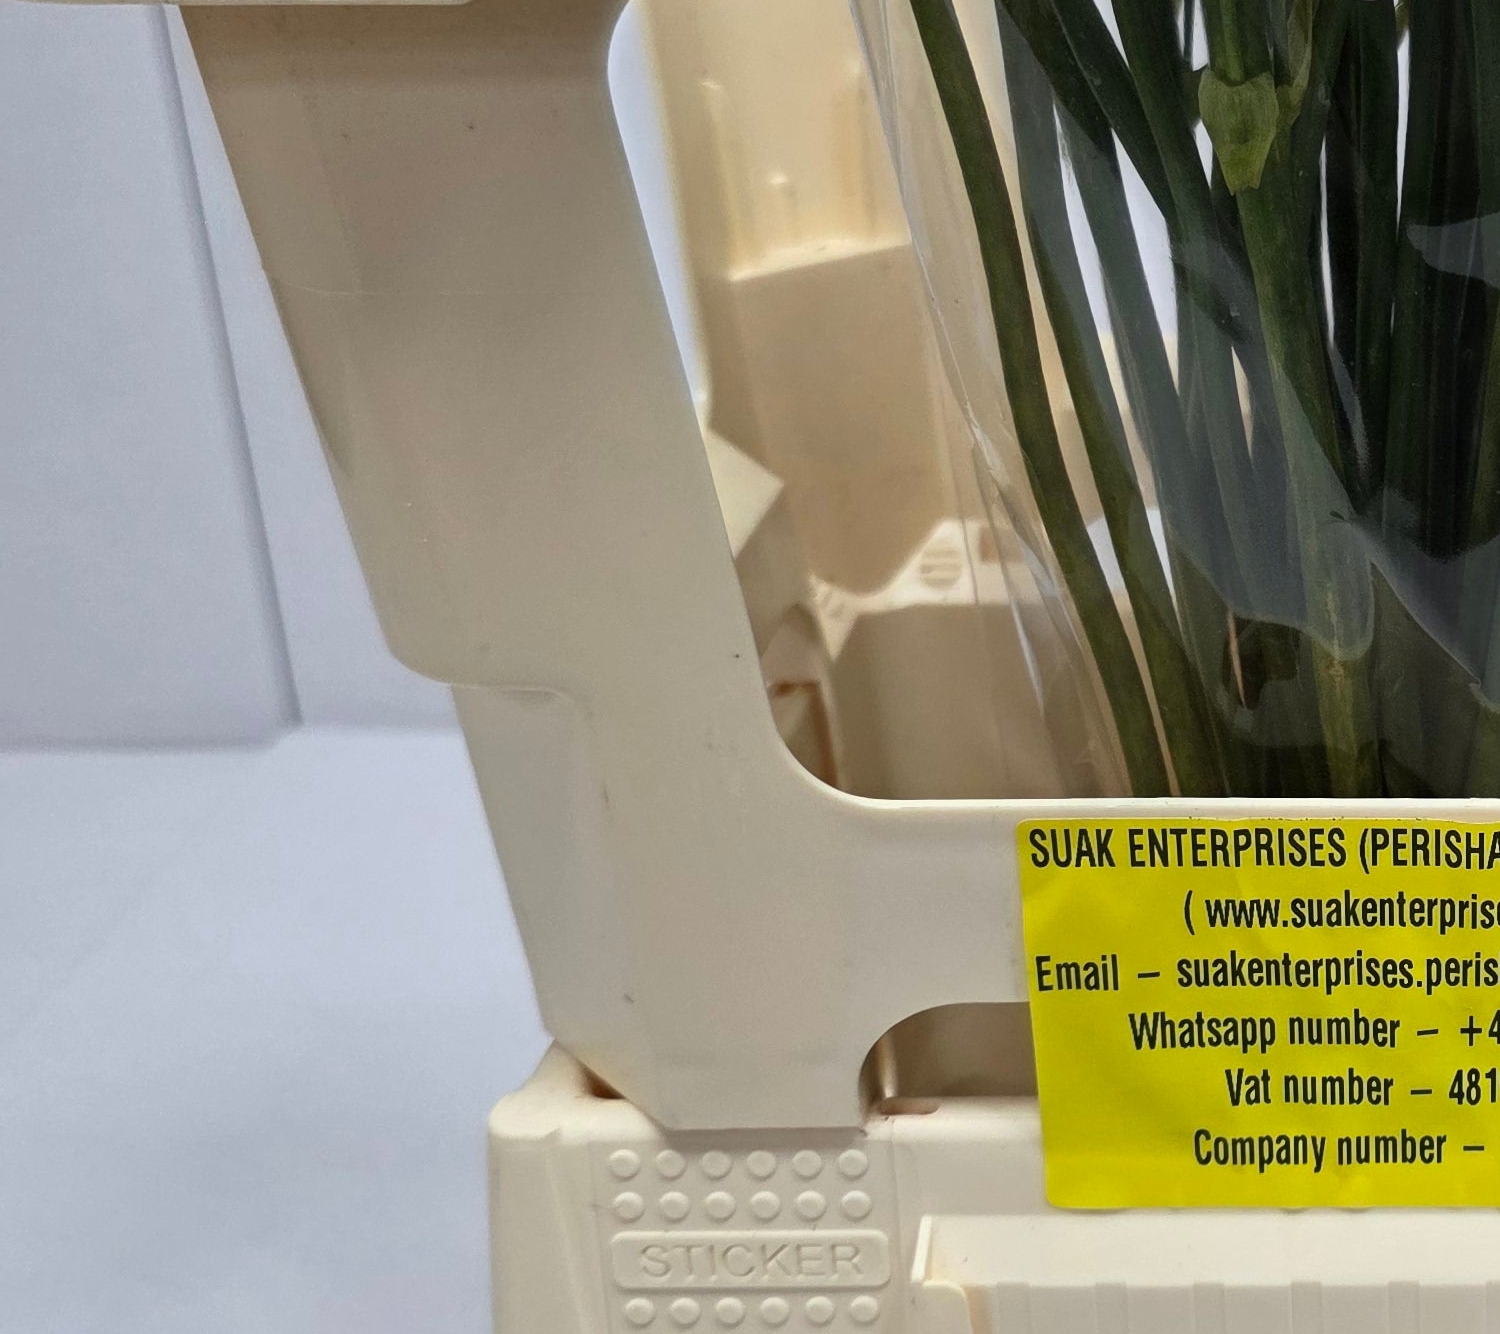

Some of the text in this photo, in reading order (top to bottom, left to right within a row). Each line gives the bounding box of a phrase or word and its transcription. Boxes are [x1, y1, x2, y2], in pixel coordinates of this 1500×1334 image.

[1028, 828, 1116, 869] SUAK
[1127, 827, 1347, 868] ENTERPRISES
[1035, 953, 1119, 992] Email
[1127, 1011, 1276, 1055] Whatsapp
[1288, 1008, 1401, 1049] number
[1224, 1067, 1272, 1107] Vat
[1283, 1067, 1394, 1106] number
[1193, 1128, 1327, 1174] Company
[1337, 1128, 1447, 1166] number
[641, 1243, 865, 1279] STICKER
